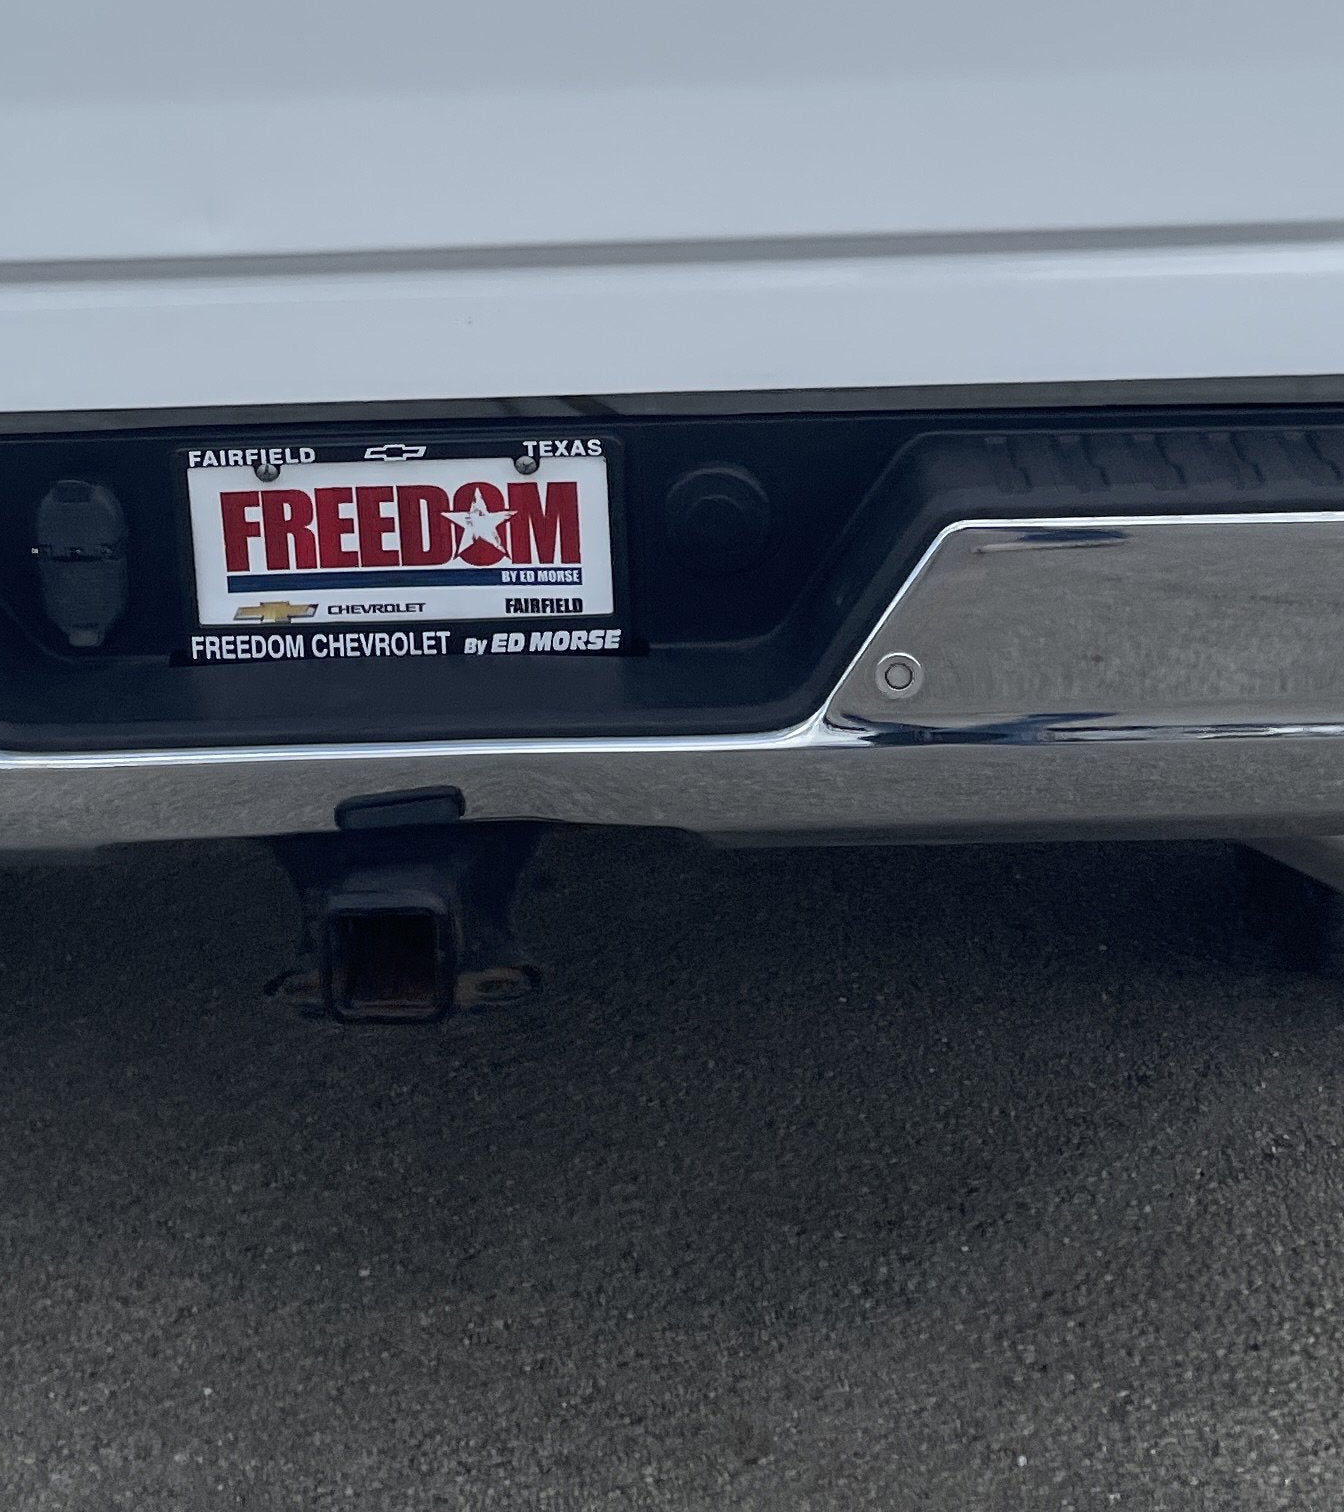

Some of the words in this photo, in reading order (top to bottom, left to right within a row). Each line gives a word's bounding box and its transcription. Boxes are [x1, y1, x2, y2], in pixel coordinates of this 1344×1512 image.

[523, 440, 603, 457] TEXAS
[188, 448, 316, 467] FAIRFIELD
[219, 481, 582, 572] FREEDOM
[501, 571, 518, 583] BY
[520, 570, 535, 582] ED
[537, 569, 580, 582] MORSE
[327, 602, 426, 615] CHEVROLET
[505, 598, 583, 614] FAIRFIELD
[191, 636, 305, 659] FREEDOM
[311, 631, 450, 657] CHEVROLET
[464, 637, 488, 656] By
[491, 634, 525, 653] ED
[529, 629, 622, 652] MORSE
